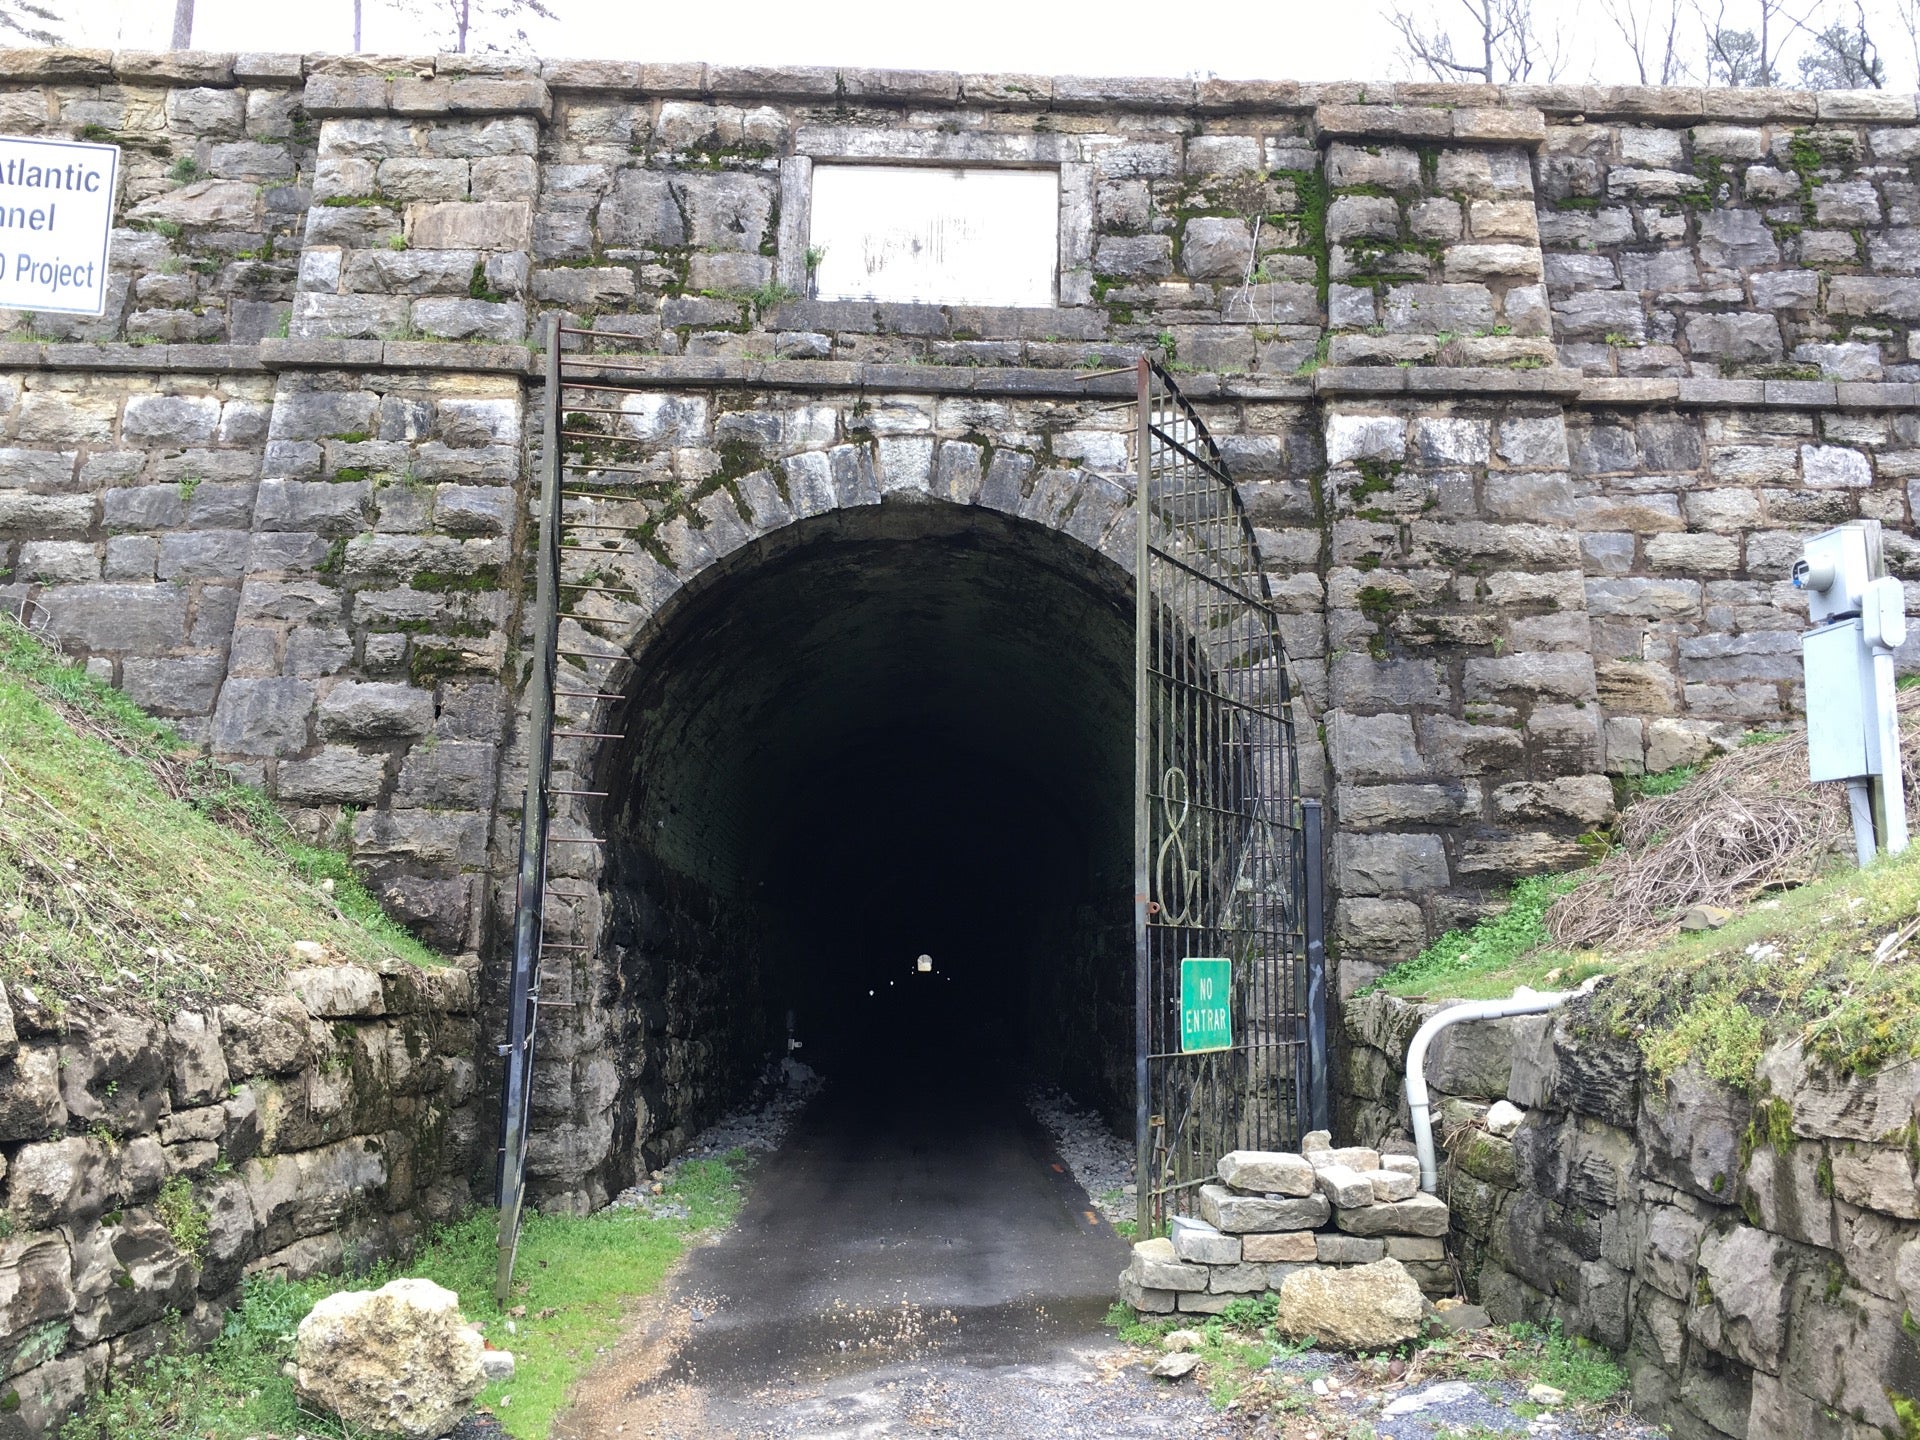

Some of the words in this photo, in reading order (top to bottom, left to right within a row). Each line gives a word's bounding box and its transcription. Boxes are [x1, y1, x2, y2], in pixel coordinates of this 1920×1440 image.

[0, 158, 101, 193] tlantic
[0, 203, 55, 231] nel
[16, 253, 94, 293] Project
[1200, 977, 1213, 1001] NO
[1186, 1008, 1227, 1034] ENTRAR
